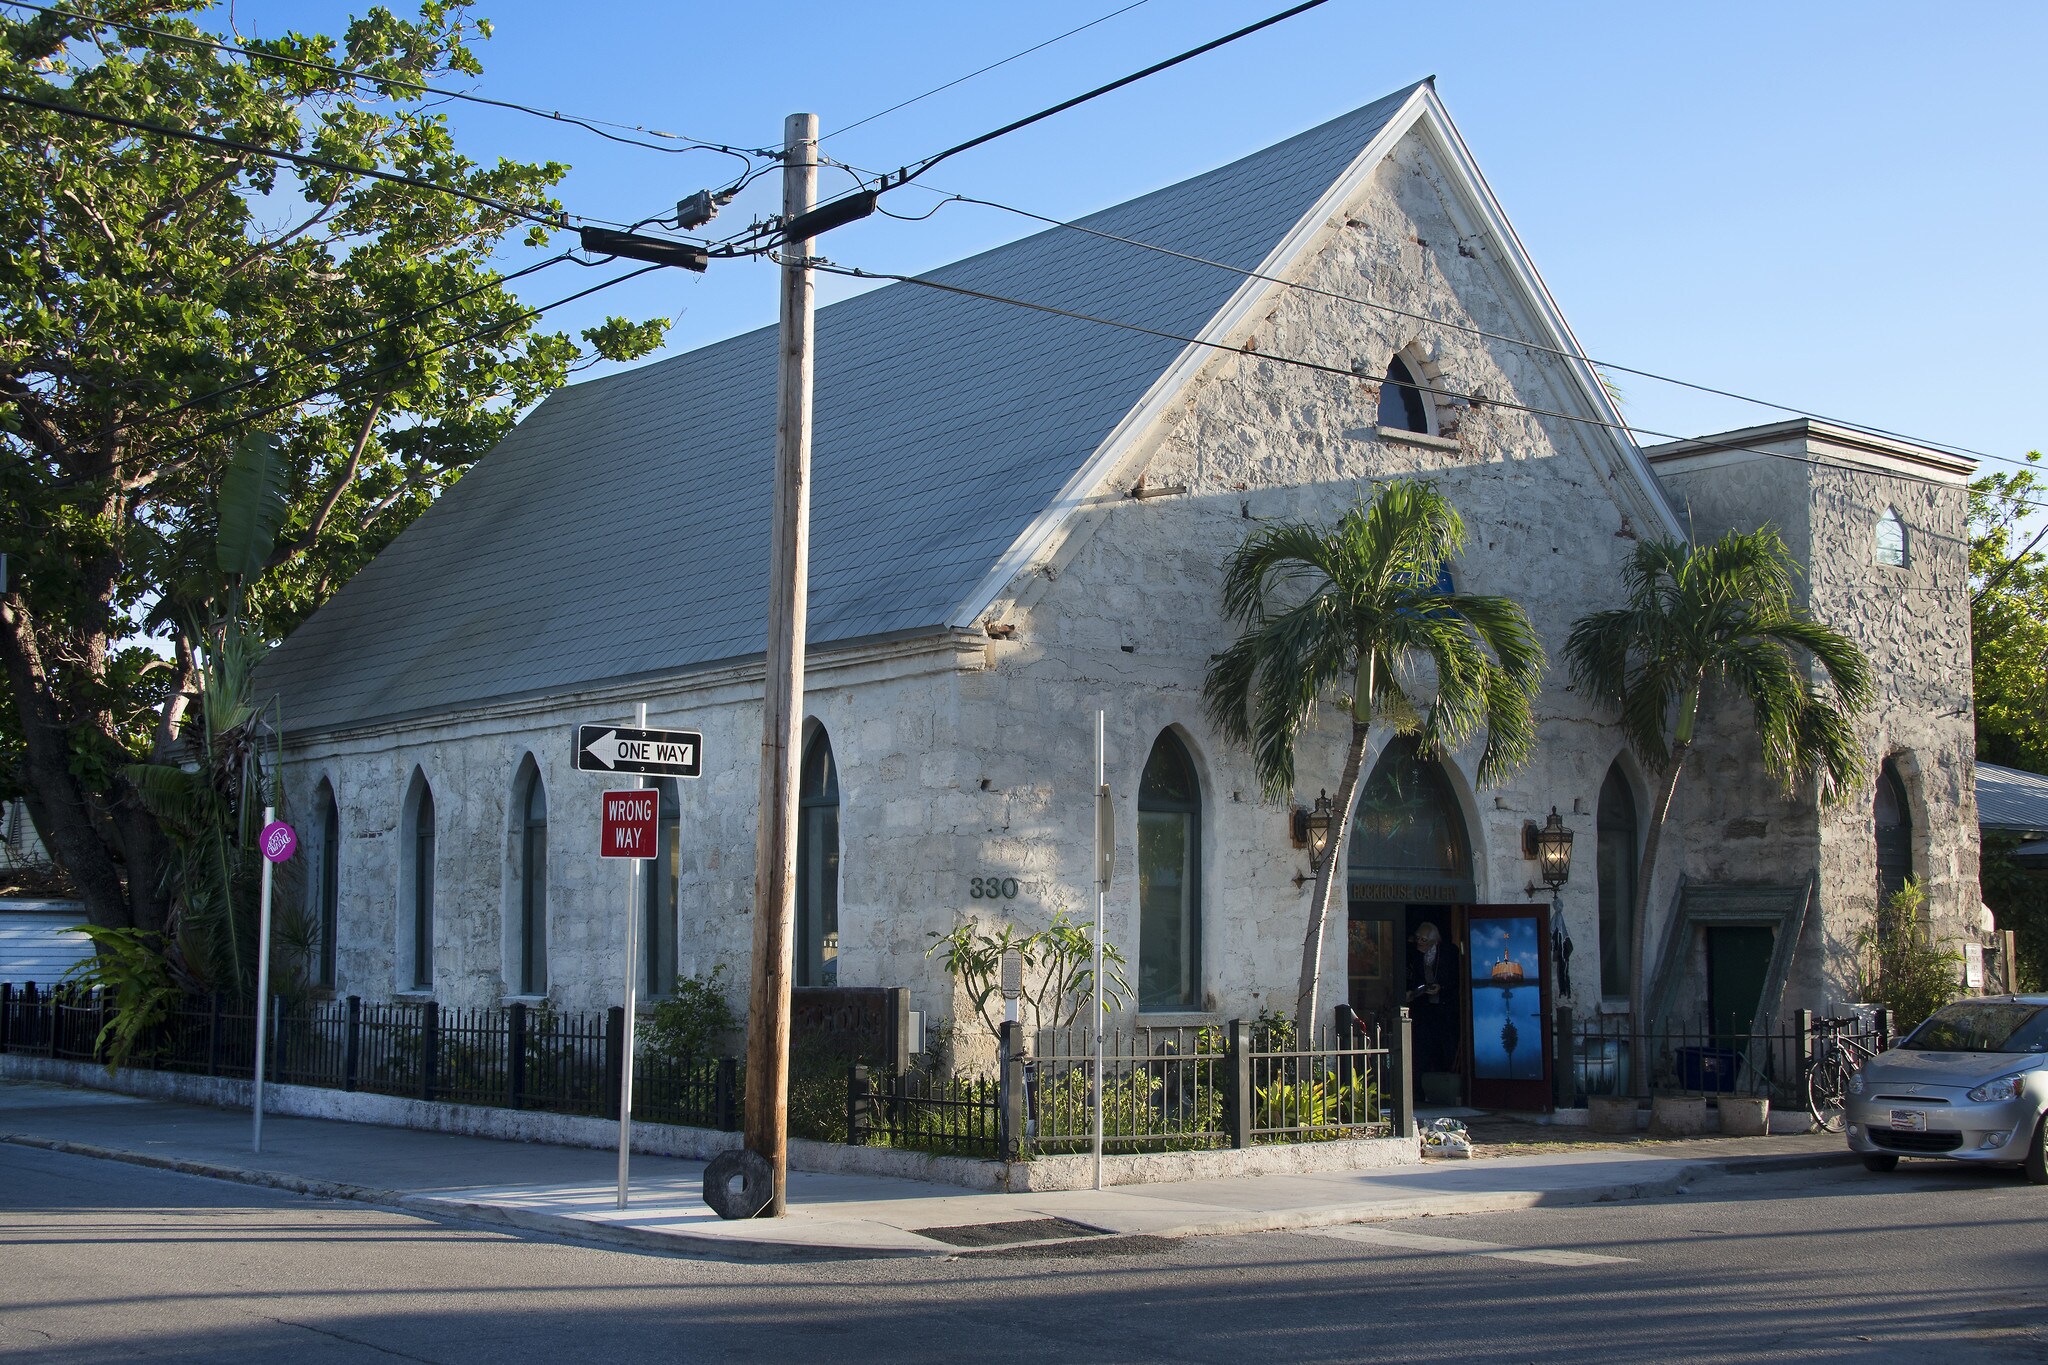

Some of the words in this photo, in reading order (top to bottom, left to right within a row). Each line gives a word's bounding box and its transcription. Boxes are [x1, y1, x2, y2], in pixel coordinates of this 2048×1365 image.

[617, 742, 651, 760] ONE
[656, 744, 689, 762] WAY
[608, 799, 652, 821] WRONG
[615, 827, 643, 849] WAY
[970, 877, 1018, 899] 330
[1353, 884, 1411, 899] ROCKHOUSE
[1416, 885, 1457, 900] GALLERY
